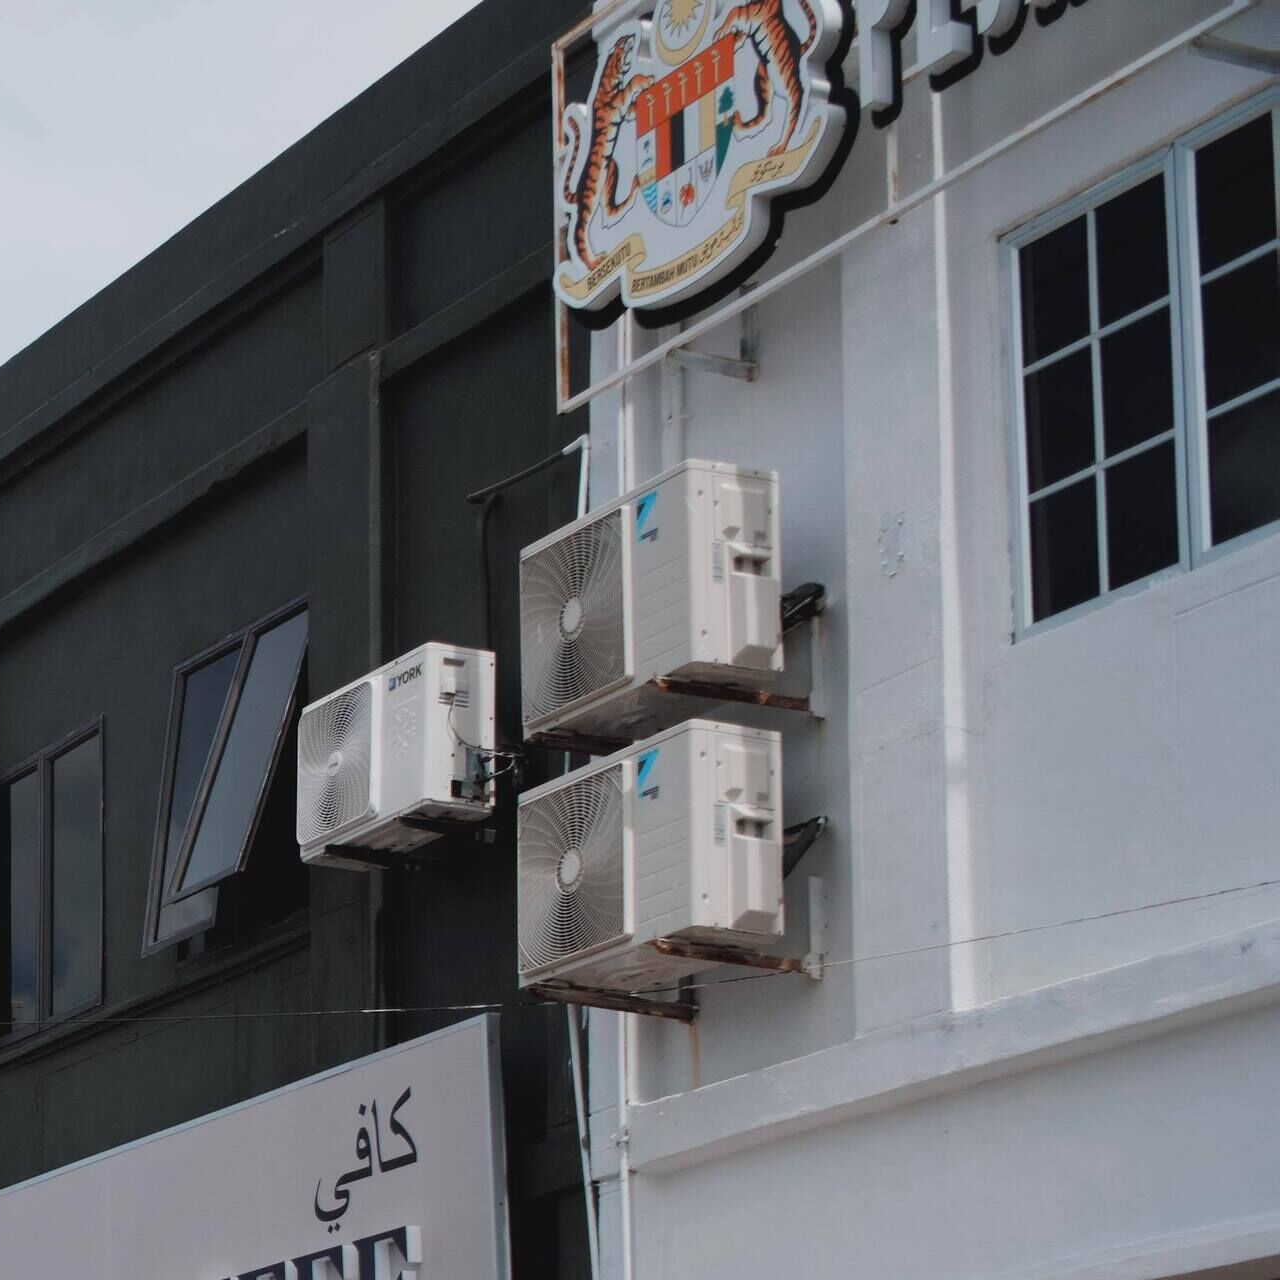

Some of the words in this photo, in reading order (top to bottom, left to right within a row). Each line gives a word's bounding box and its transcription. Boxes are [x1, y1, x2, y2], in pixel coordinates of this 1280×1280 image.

[586, 242, 631, 291] BERSEKUTU
[631, 267, 676, 294] BERTAMBAH
[676, 254, 699, 276] MUTU
[395, 663, 422, 688] YORK
